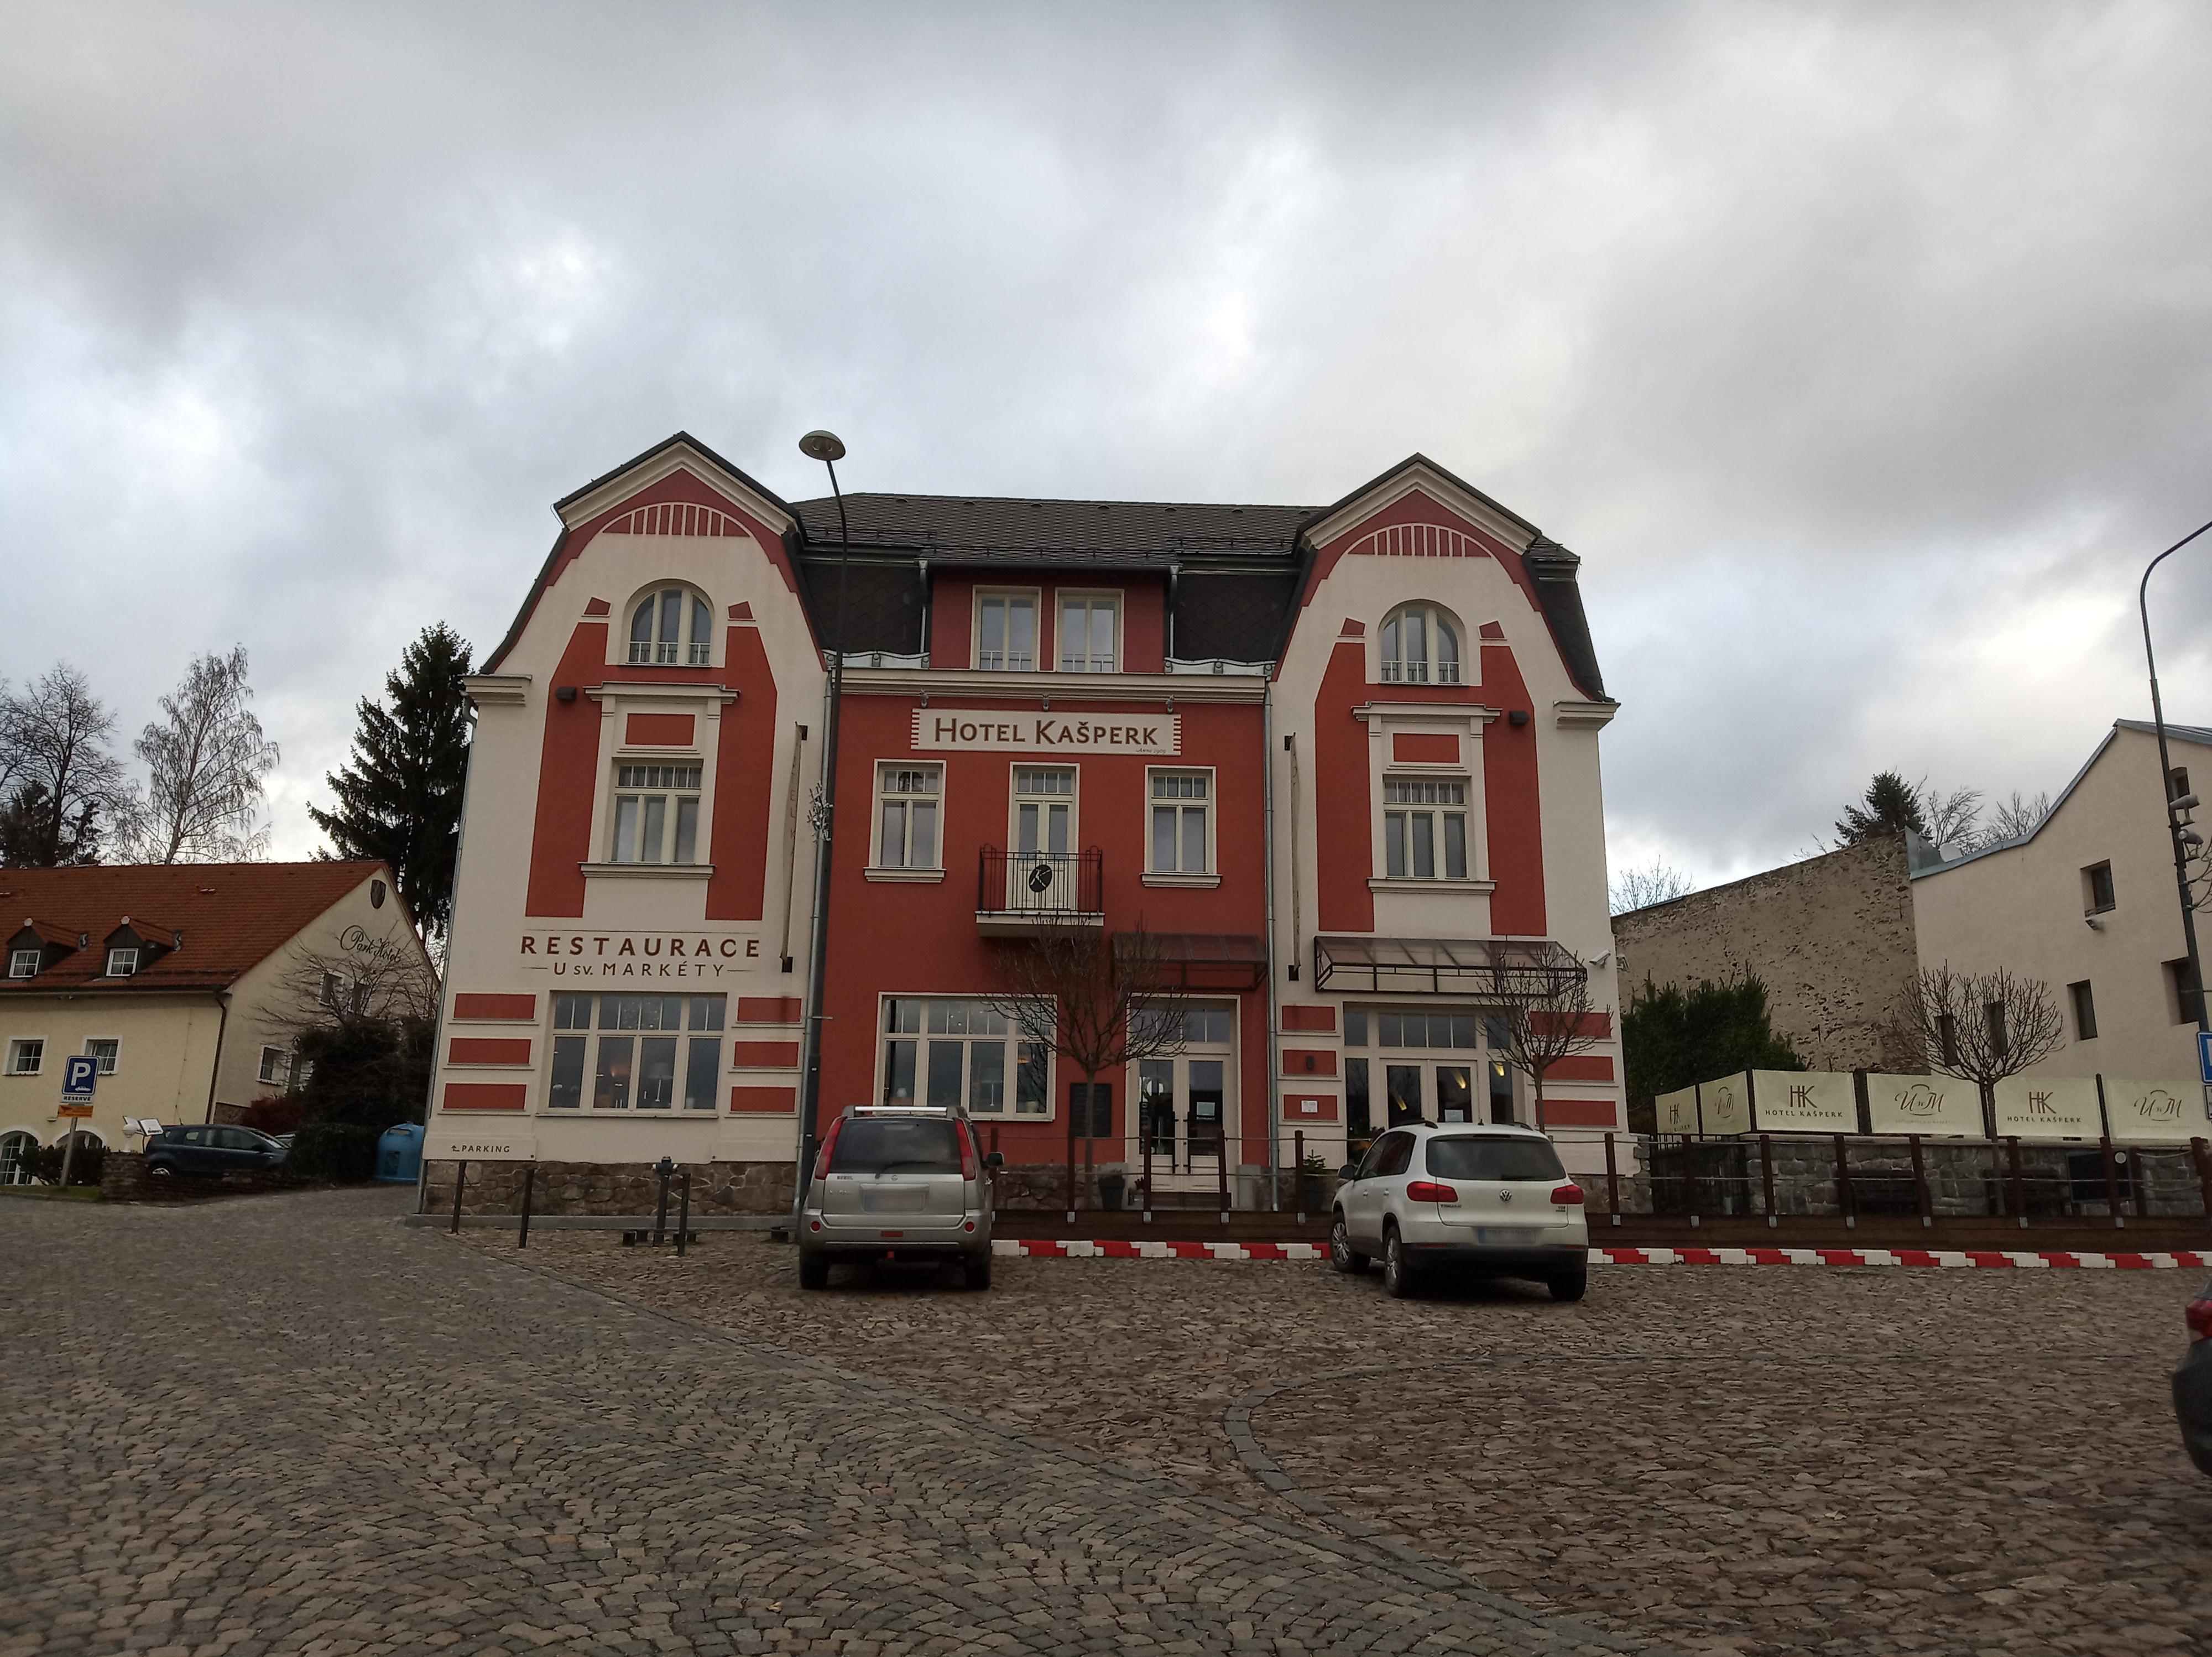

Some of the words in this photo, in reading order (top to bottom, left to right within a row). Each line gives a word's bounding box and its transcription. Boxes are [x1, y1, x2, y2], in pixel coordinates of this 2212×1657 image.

[340, 925, 374, 955] Park
[373, 937, 401, 963] Hotel
[520, 936, 760, 958] RESTAURACE
[554, 962, 566, 976] U
[602, 960, 724, 977] MARKÉTY
[70, 1062, 91, 1086] P
[1790, 1085, 1818, 1108] HK
[2028, 1091, 2057, 1114] HK
[461, 1145, 510, 1153] PARKING
